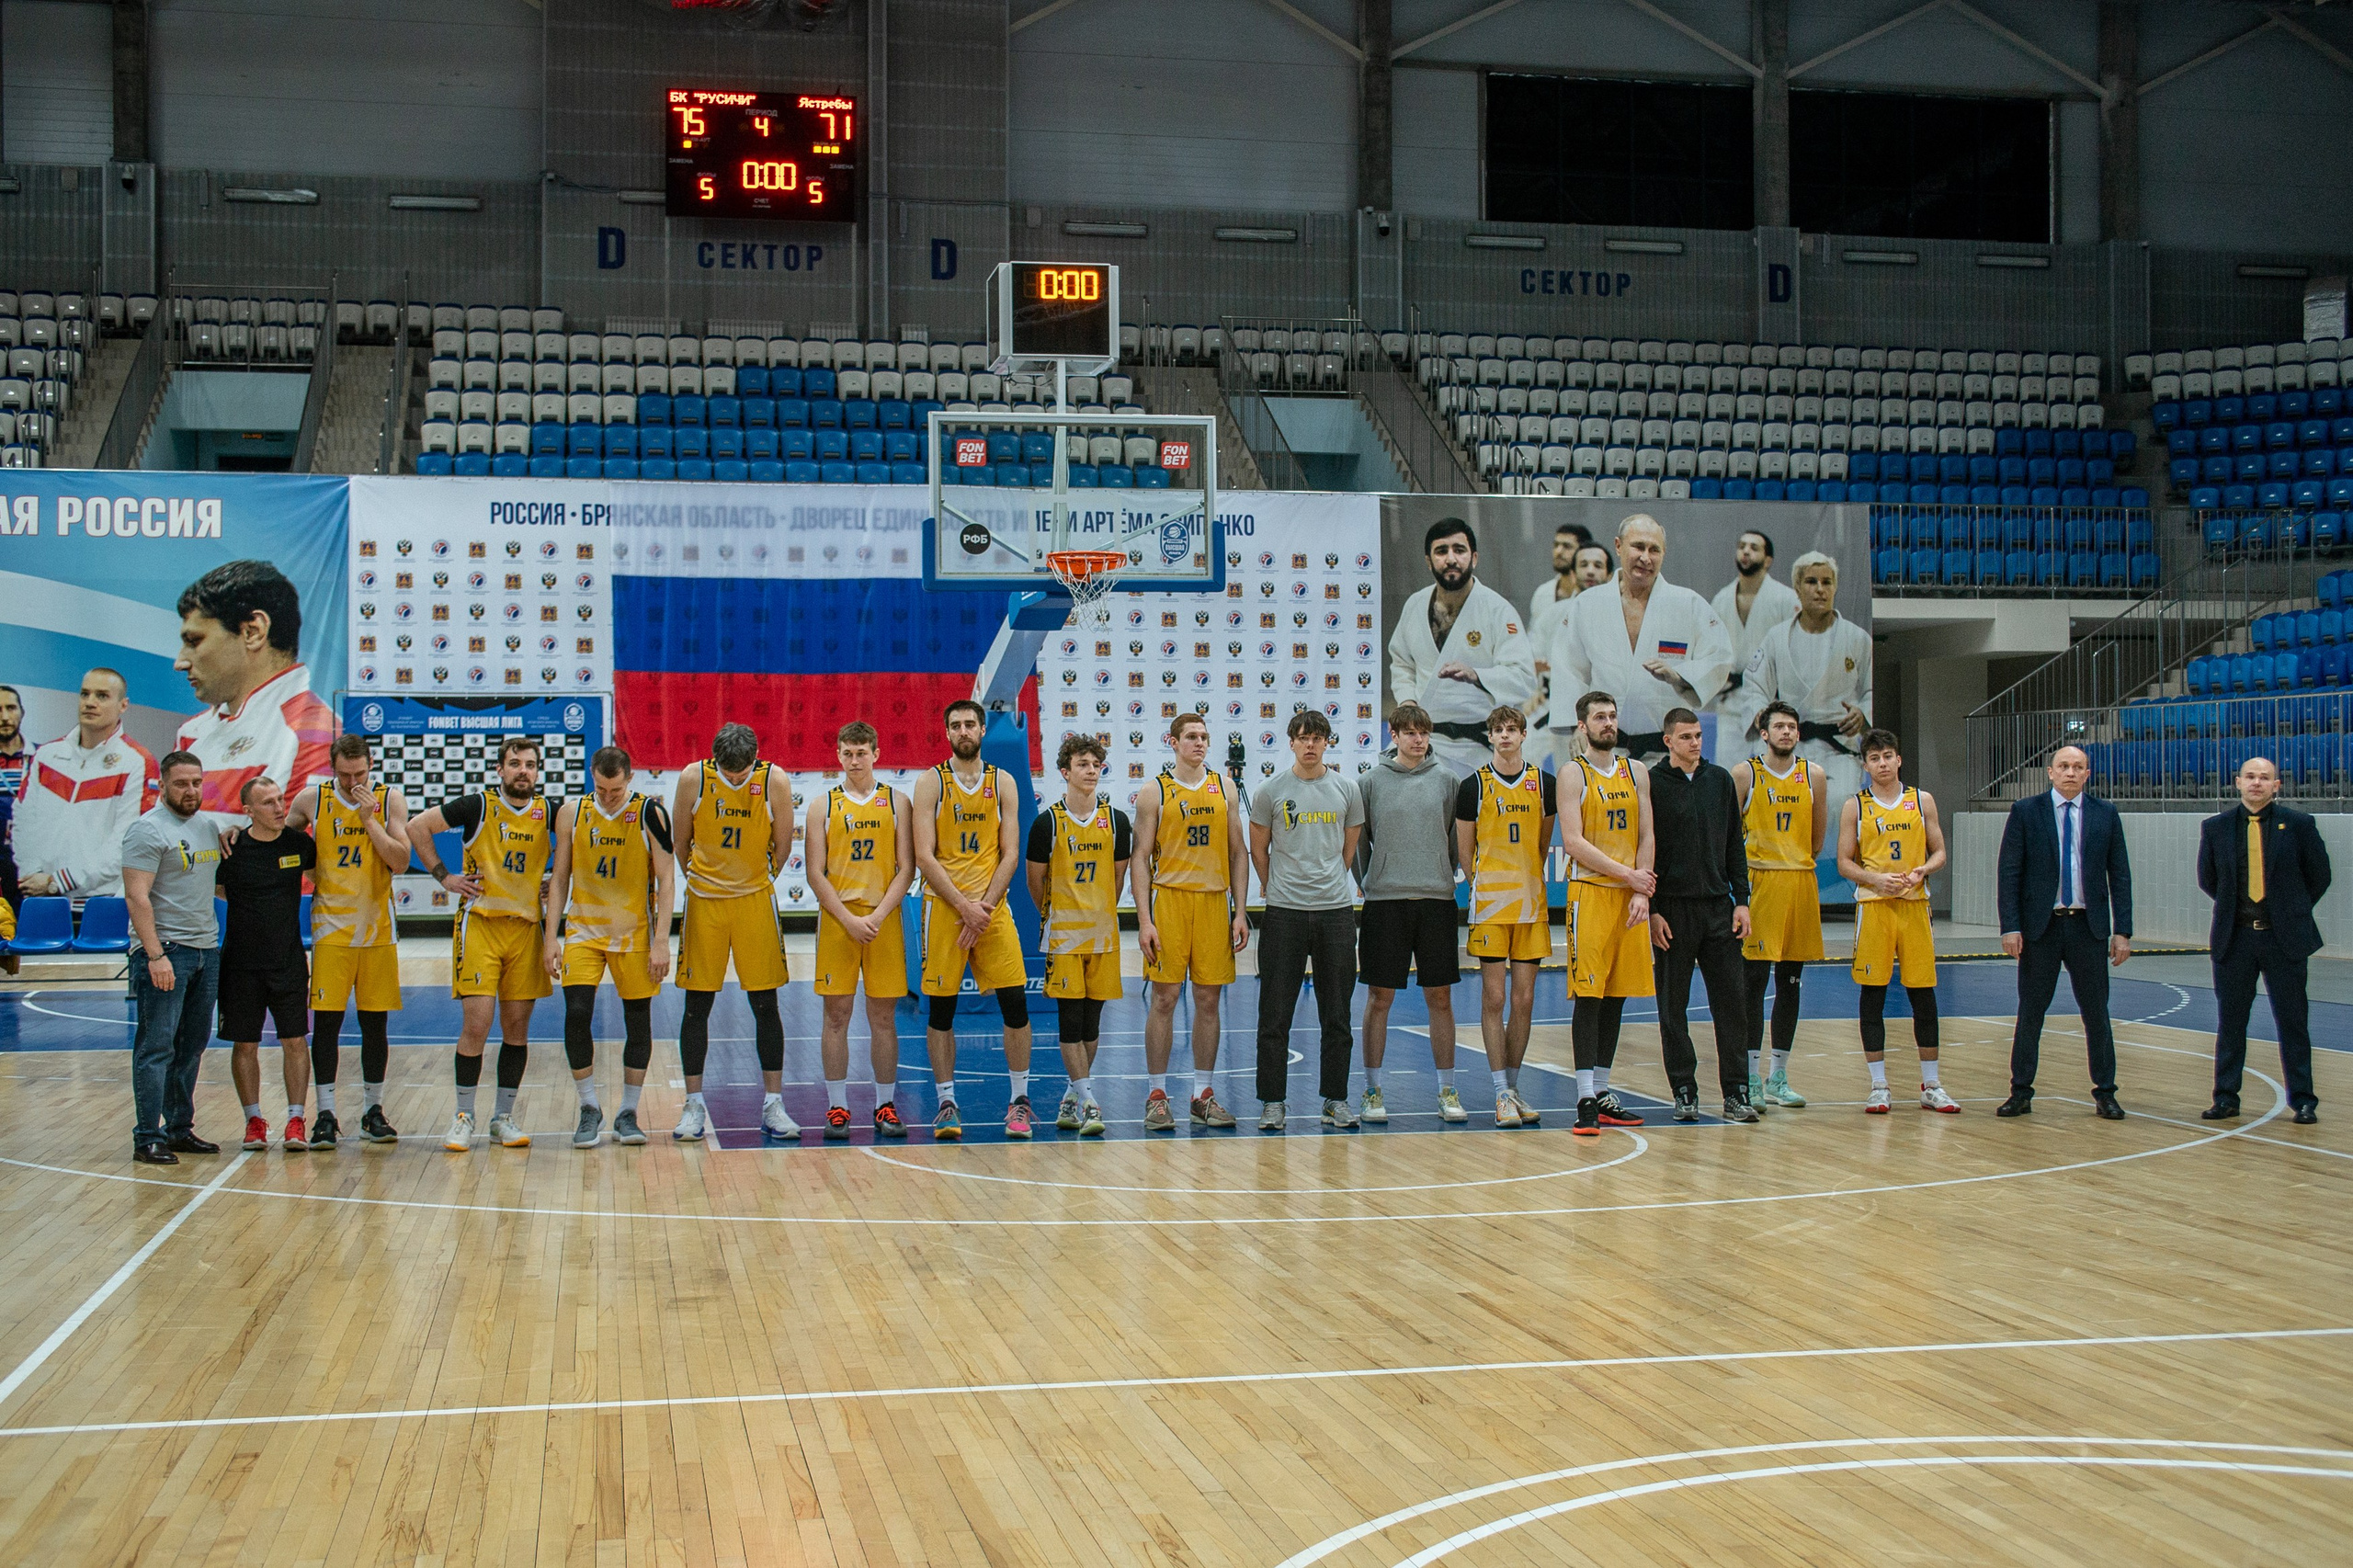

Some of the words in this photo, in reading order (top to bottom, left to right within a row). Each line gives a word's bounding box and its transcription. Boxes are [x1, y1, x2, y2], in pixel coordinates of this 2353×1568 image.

[669, 92, 688, 103] БК
[798, 97, 853, 110] Ястребы
[673, 107, 705, 136] 75
[745, 108, 779, 118] ПЕРИОД
[754, 118, 768, 137] 4
[819, 113, 851, 140] 71
[743, 162, 797, 191] 0:00
[699, 178, 714, 200] 5
[809, 182, 824, 204] 5
[597, 226, 627, 270] D
[697, 241, 824, 272] СЕКТОР
[930, 238, 958, 280] D
[1040, 270, 1098, 301] 0:00
[1520, 268, 1631, 298] СЕКТОР
[1768, 263, 1791, 303] D
[959, 443, 984, 452] FON
[959, 452, 984, 463] BET
[1164, 445, 1188, 455] FON
[1164, 455, 1188, 465] BET
[57, 495, 222, 539] РОССИЯ
[490, 502, 565, 526] РОССИЯ
[581, 504, 683, 528] БРЯНСКАЯ
[688, 505, 777, 529] ОБЛАСТЬ
[789, 506, 867, 532] ДВОРЕЦ
[962, 534, 988, 544] РФБ
[428, 716, 460, 729] FONBET
[460, 716, 500, 729] ВЫСШАЯ
[501, 716, 523, 729] ЛИГА
[1606, 808, 1627, 831] 73
[1776, 811, 1792, 833] 17
[721, 826, 742, 849] 21
[960, 831, 980, 854] 14
[1187, 824, 1210, 847] 38
[1508, 822, 1520, 844] 0
[337, 845, 362, 868] 24
[851, 838, 875, 861] 32
[1890, 840, 1903, 860] 3
[502, 850, 526, 873] 43
[596, 856, 618, 879] 41
[1074, 861, 1097, 884] 27
